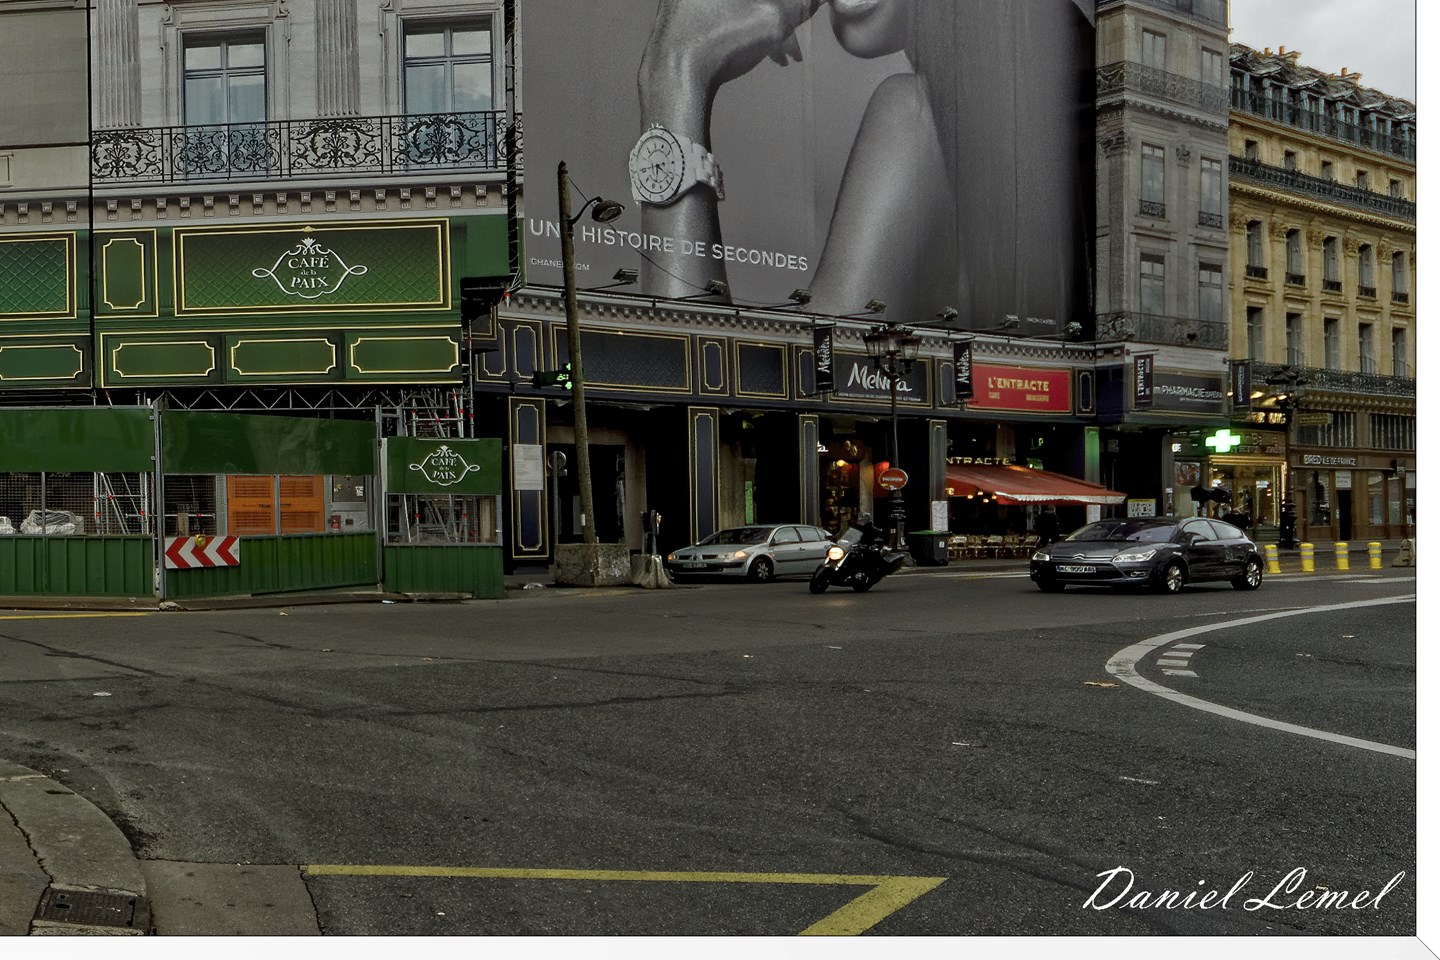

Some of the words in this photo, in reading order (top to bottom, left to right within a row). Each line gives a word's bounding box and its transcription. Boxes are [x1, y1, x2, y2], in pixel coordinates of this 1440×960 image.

[530, 218, 561, 238] UN
[582, 225, 675, 254] HISTOIRE
[681, 240, 706, 257] DE
[711, 243, 808, 271] SECONDES
[288, 255, 329, 269] CAFÉ
[290, 276, 329, 289] PAIX
[847, 362, 912, 391] Melvia
[988, 376, 1050, 392] L'ENTRACTE
[1161, 385, 1206, 397] PHARMACIE
[433, 470, 456, 480] PAIX
